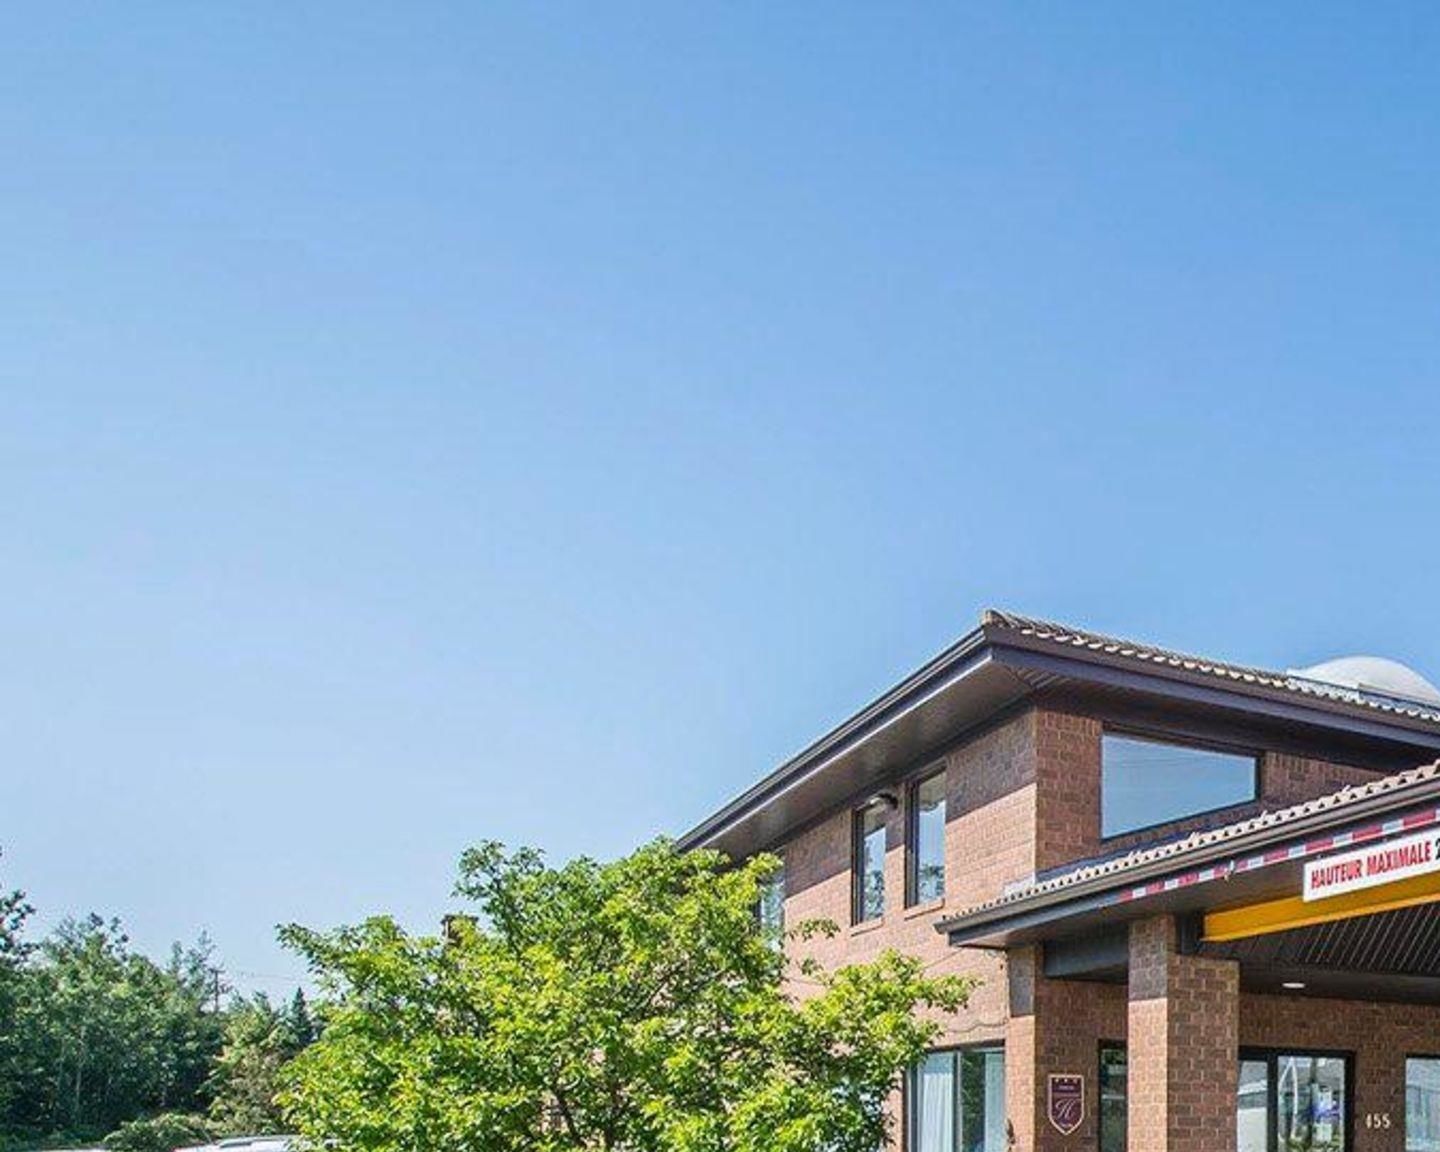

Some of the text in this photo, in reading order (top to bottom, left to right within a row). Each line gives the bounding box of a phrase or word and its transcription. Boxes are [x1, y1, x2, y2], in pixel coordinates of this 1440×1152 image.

[1311, 860, 1363, 889] HAUTEUR
[1367, 841, 1432, 875] MAXIMALE
[1366, 1113, 1390, 1129] 155
